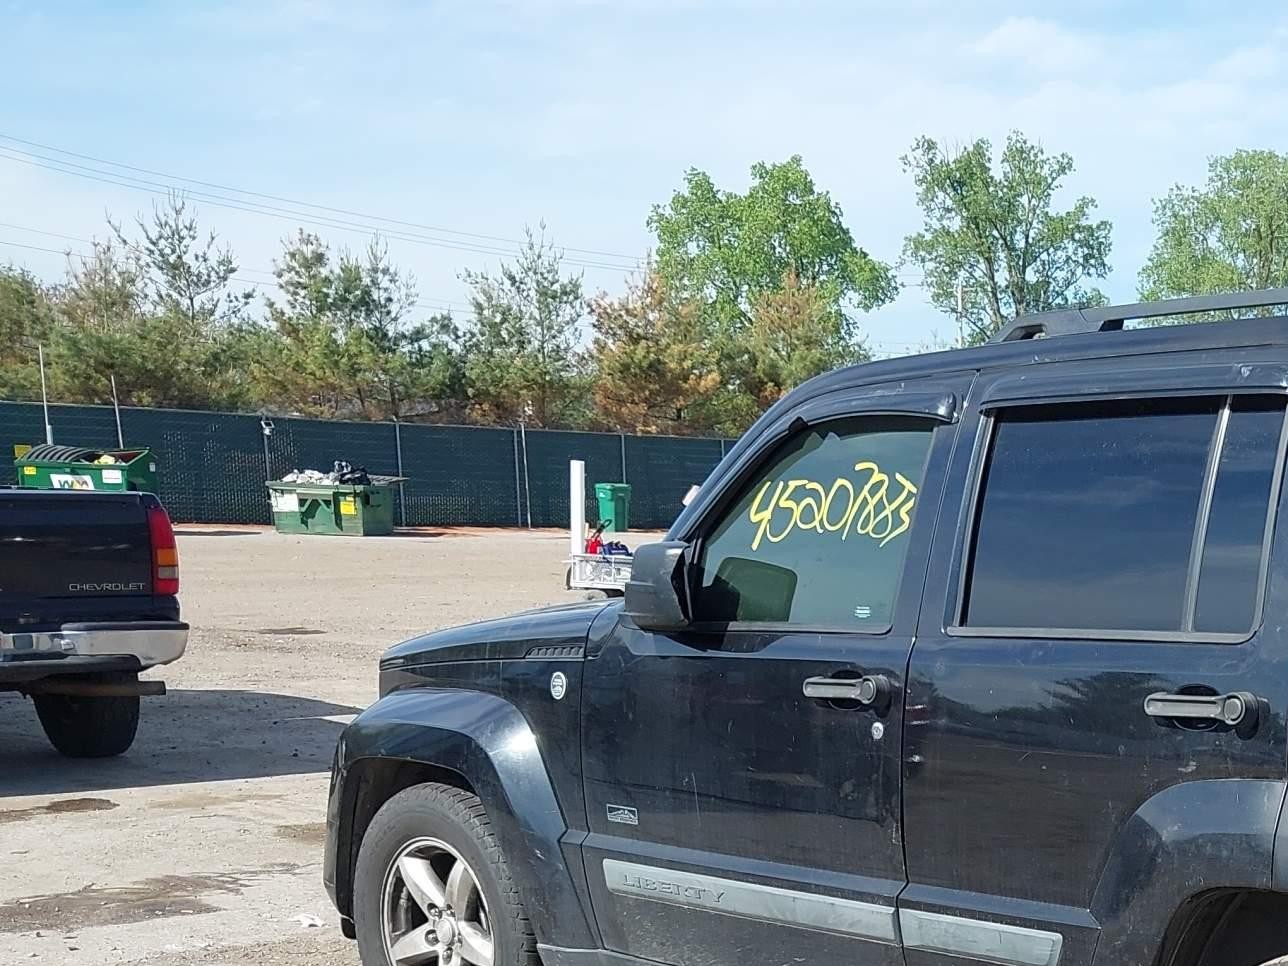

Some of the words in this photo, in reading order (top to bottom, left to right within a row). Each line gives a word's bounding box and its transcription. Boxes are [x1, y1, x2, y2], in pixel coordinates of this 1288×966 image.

[749, 460, 919, 551] 45207883
[69, 582, 145, 591] CHEVROLET
[624, 875, 725, 903] LIBERTY
